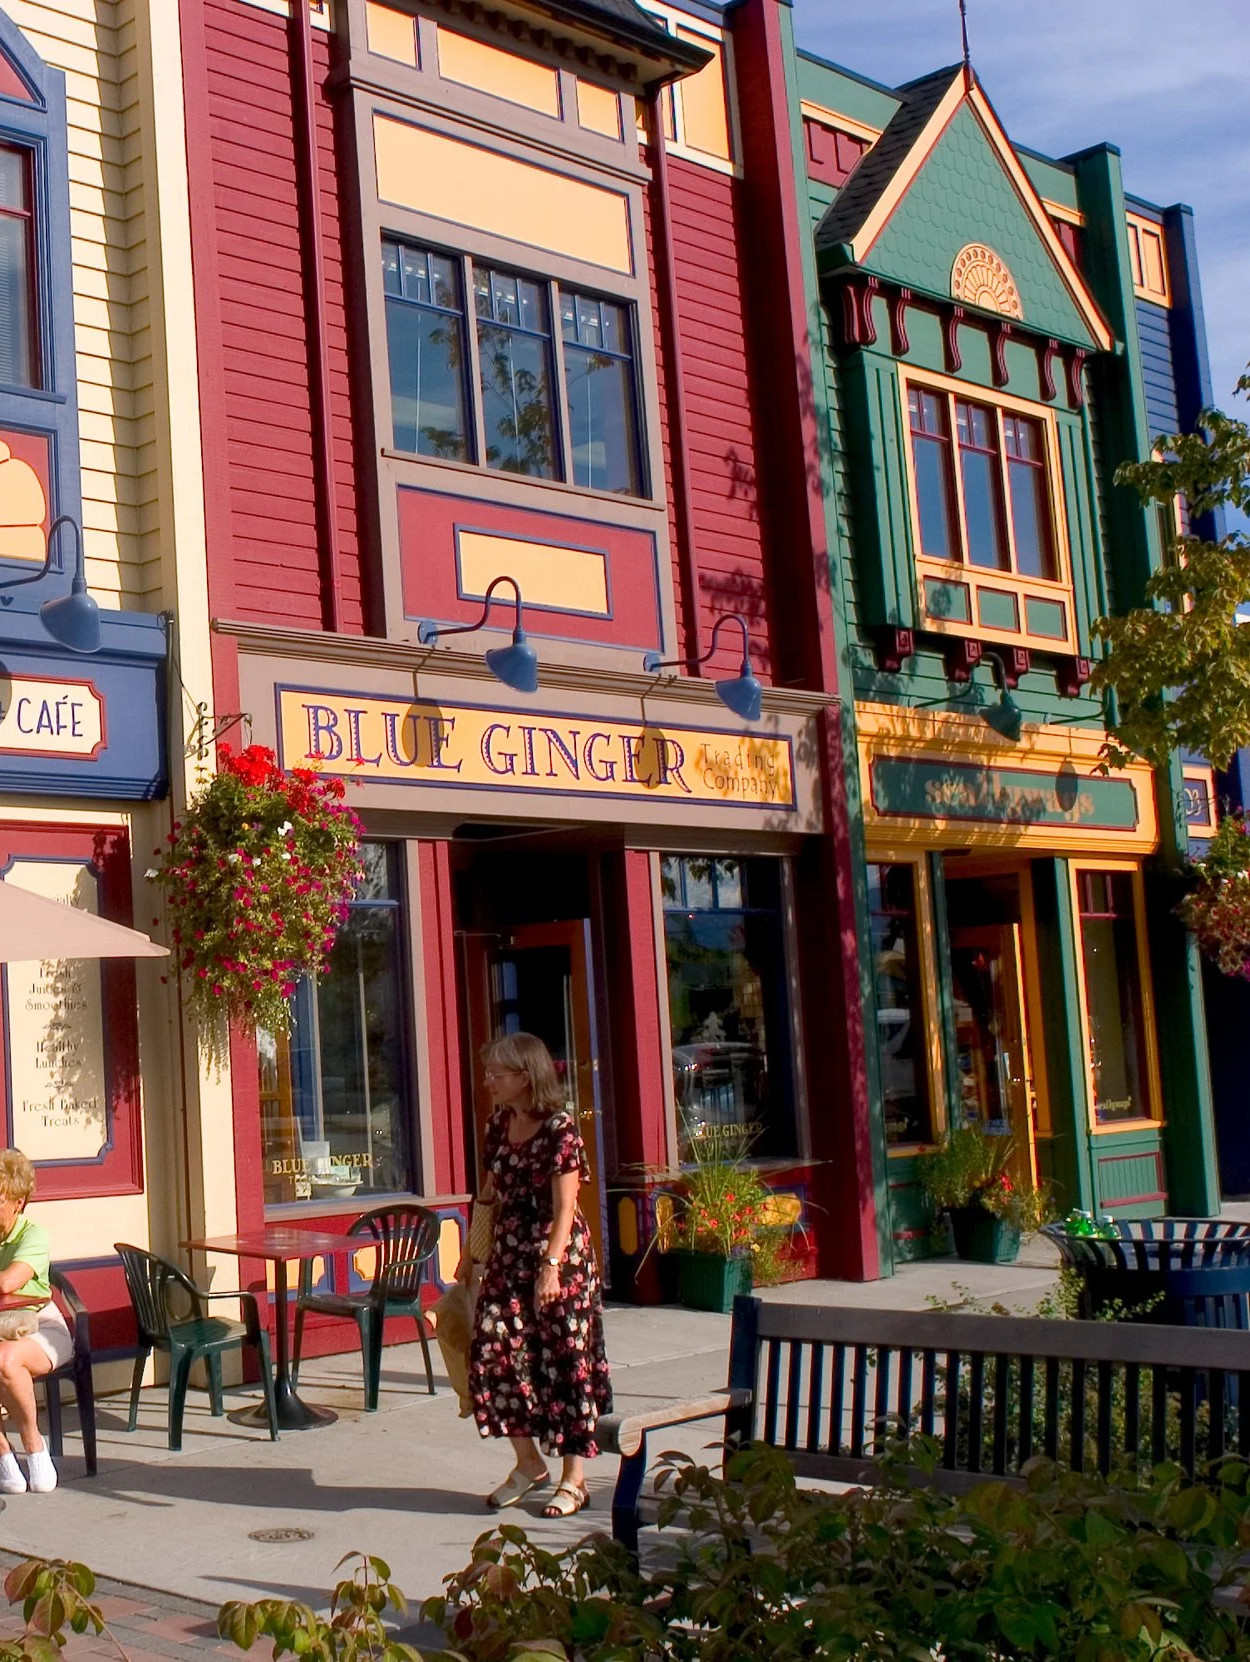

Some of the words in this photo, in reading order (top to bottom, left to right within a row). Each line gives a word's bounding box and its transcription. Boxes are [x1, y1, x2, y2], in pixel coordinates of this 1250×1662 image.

[17, 694, 83, 737] CAFÉ
[302, 704, 462, 773] BLUE
[480, 722, 692, 793] GINGER
[700, 743, 776, 776] Trading
[702, 768, 778, 801] Company
[24, 997, 88, 1011] Smoothies
[36, 1039, 79, 1056] Healthy
[35, 1056, 82, 1069] Lunches
[42, 1116, 80, 1127] Treats
